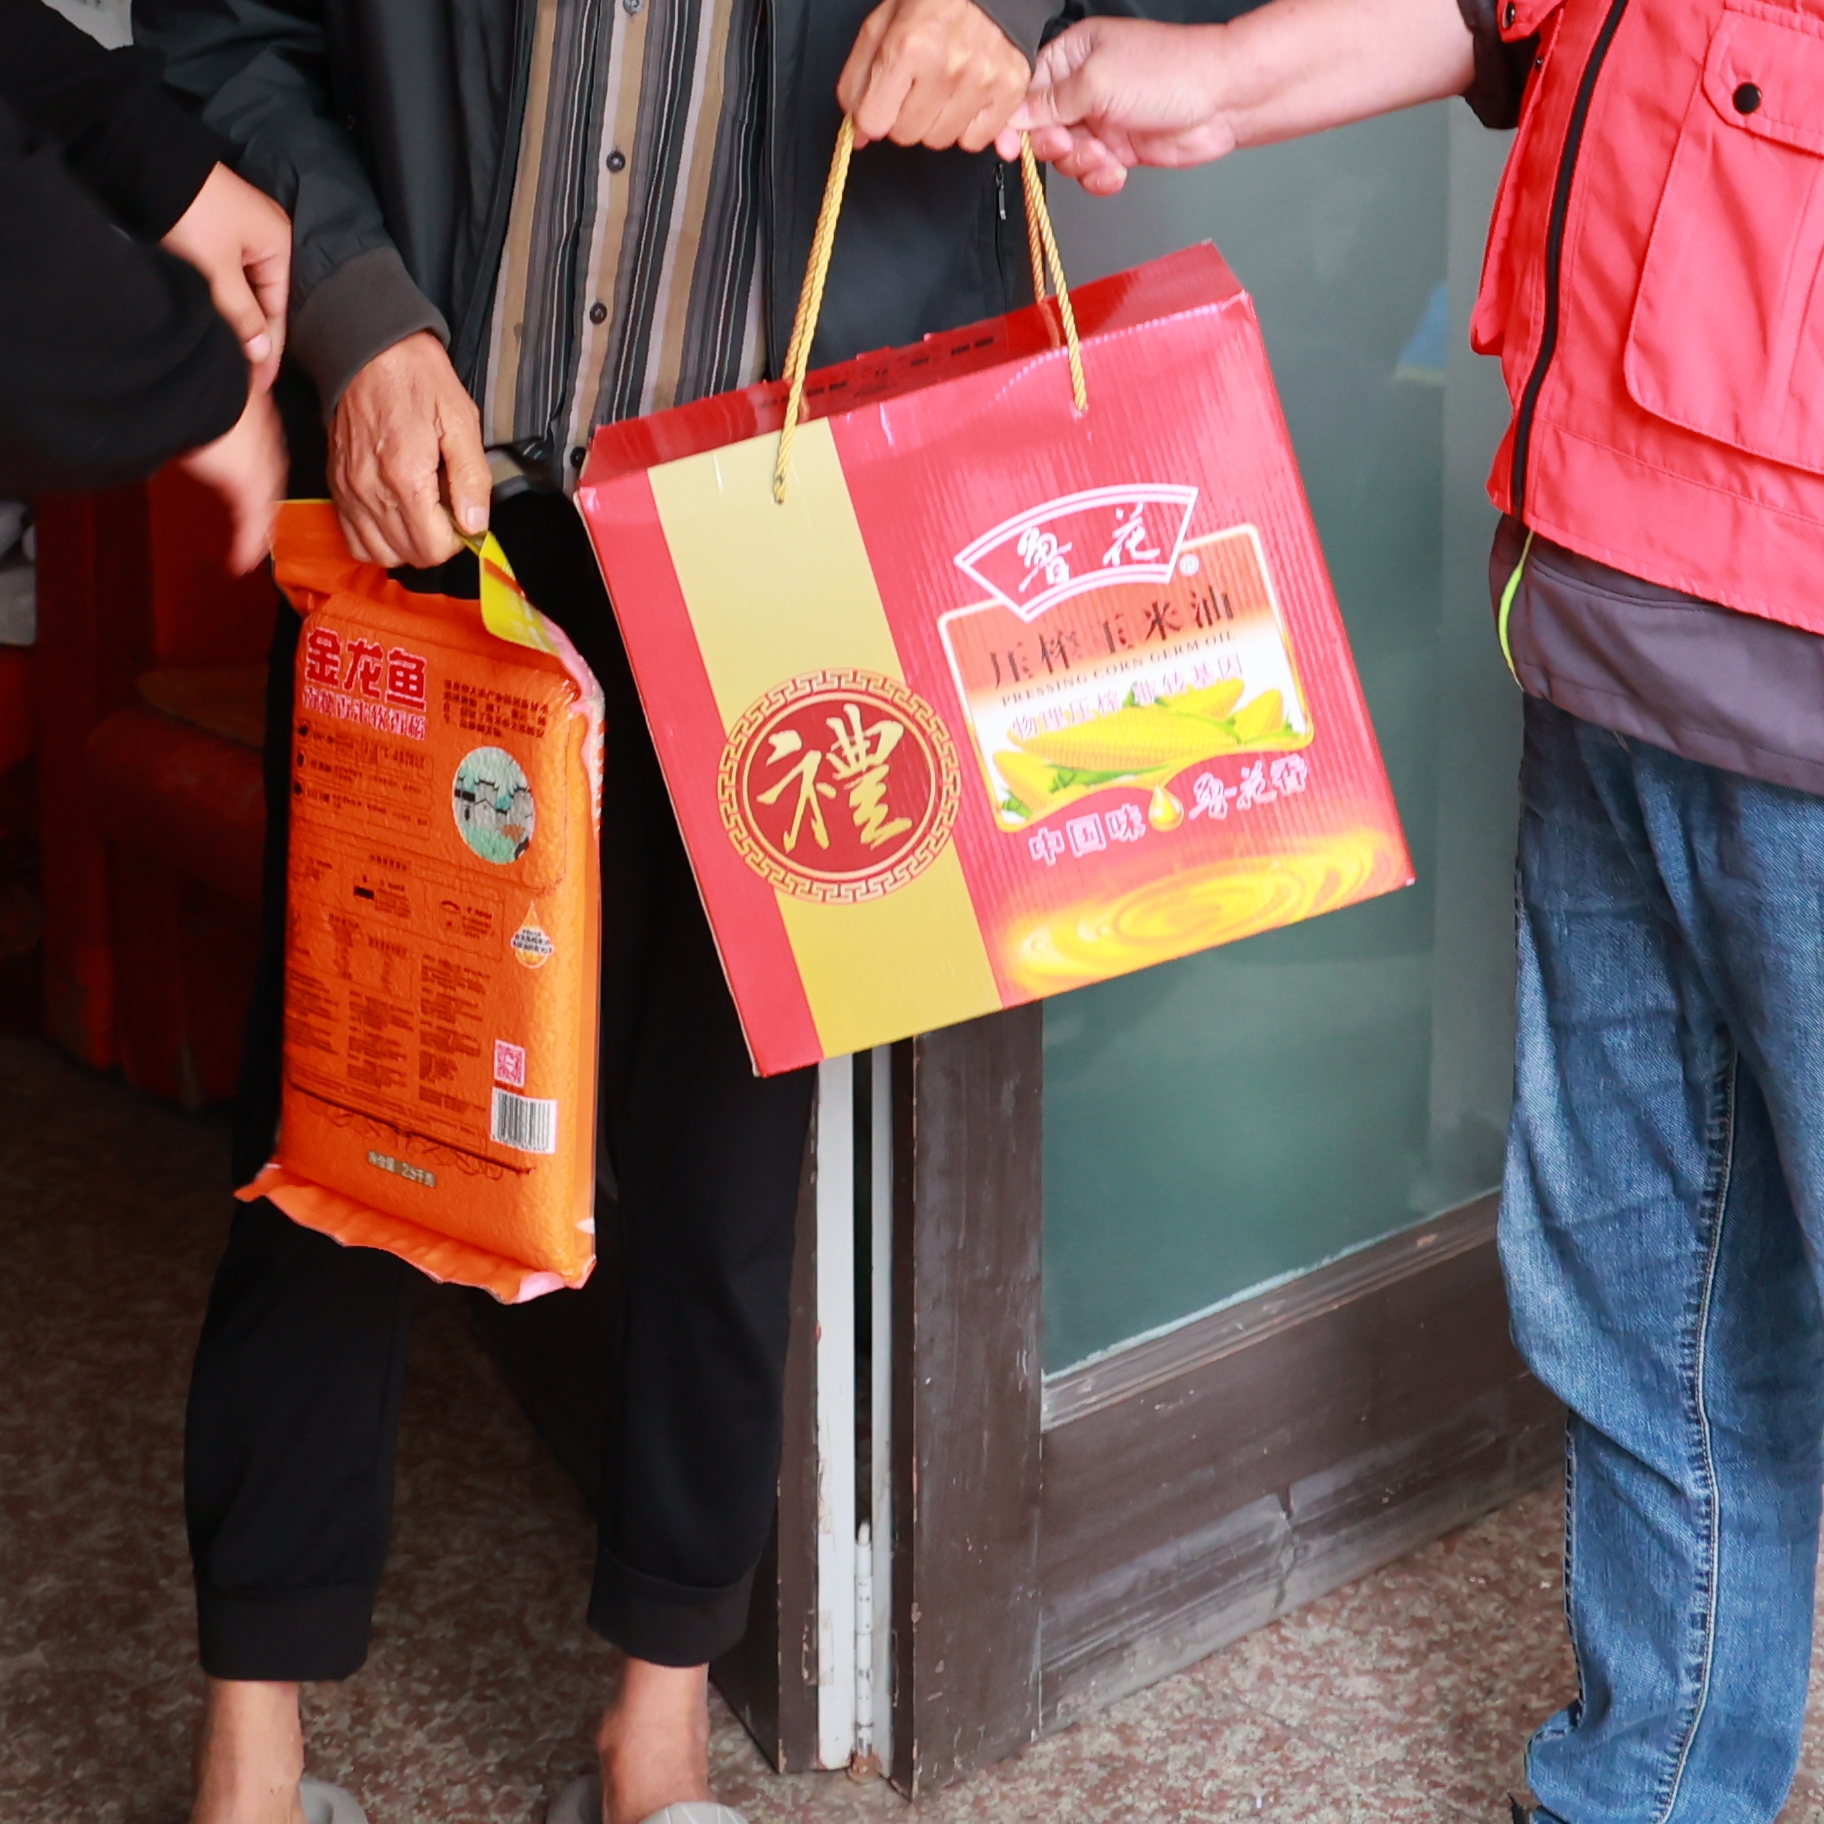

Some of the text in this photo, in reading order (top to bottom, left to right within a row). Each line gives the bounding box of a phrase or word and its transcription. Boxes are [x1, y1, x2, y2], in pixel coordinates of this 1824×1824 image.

[1016, 501, 1161, 594] 鲁花
[304, 626, 427, 711] 金龙鱼
[1001, 631, 1237, 708] PRESSING CORN GERM OIL
[1012, 652, 1245, 740] 物理压榨 非转基因
[756, 702, 914, 855] 禮
[1028, 802, 1146, 866] 中国味
